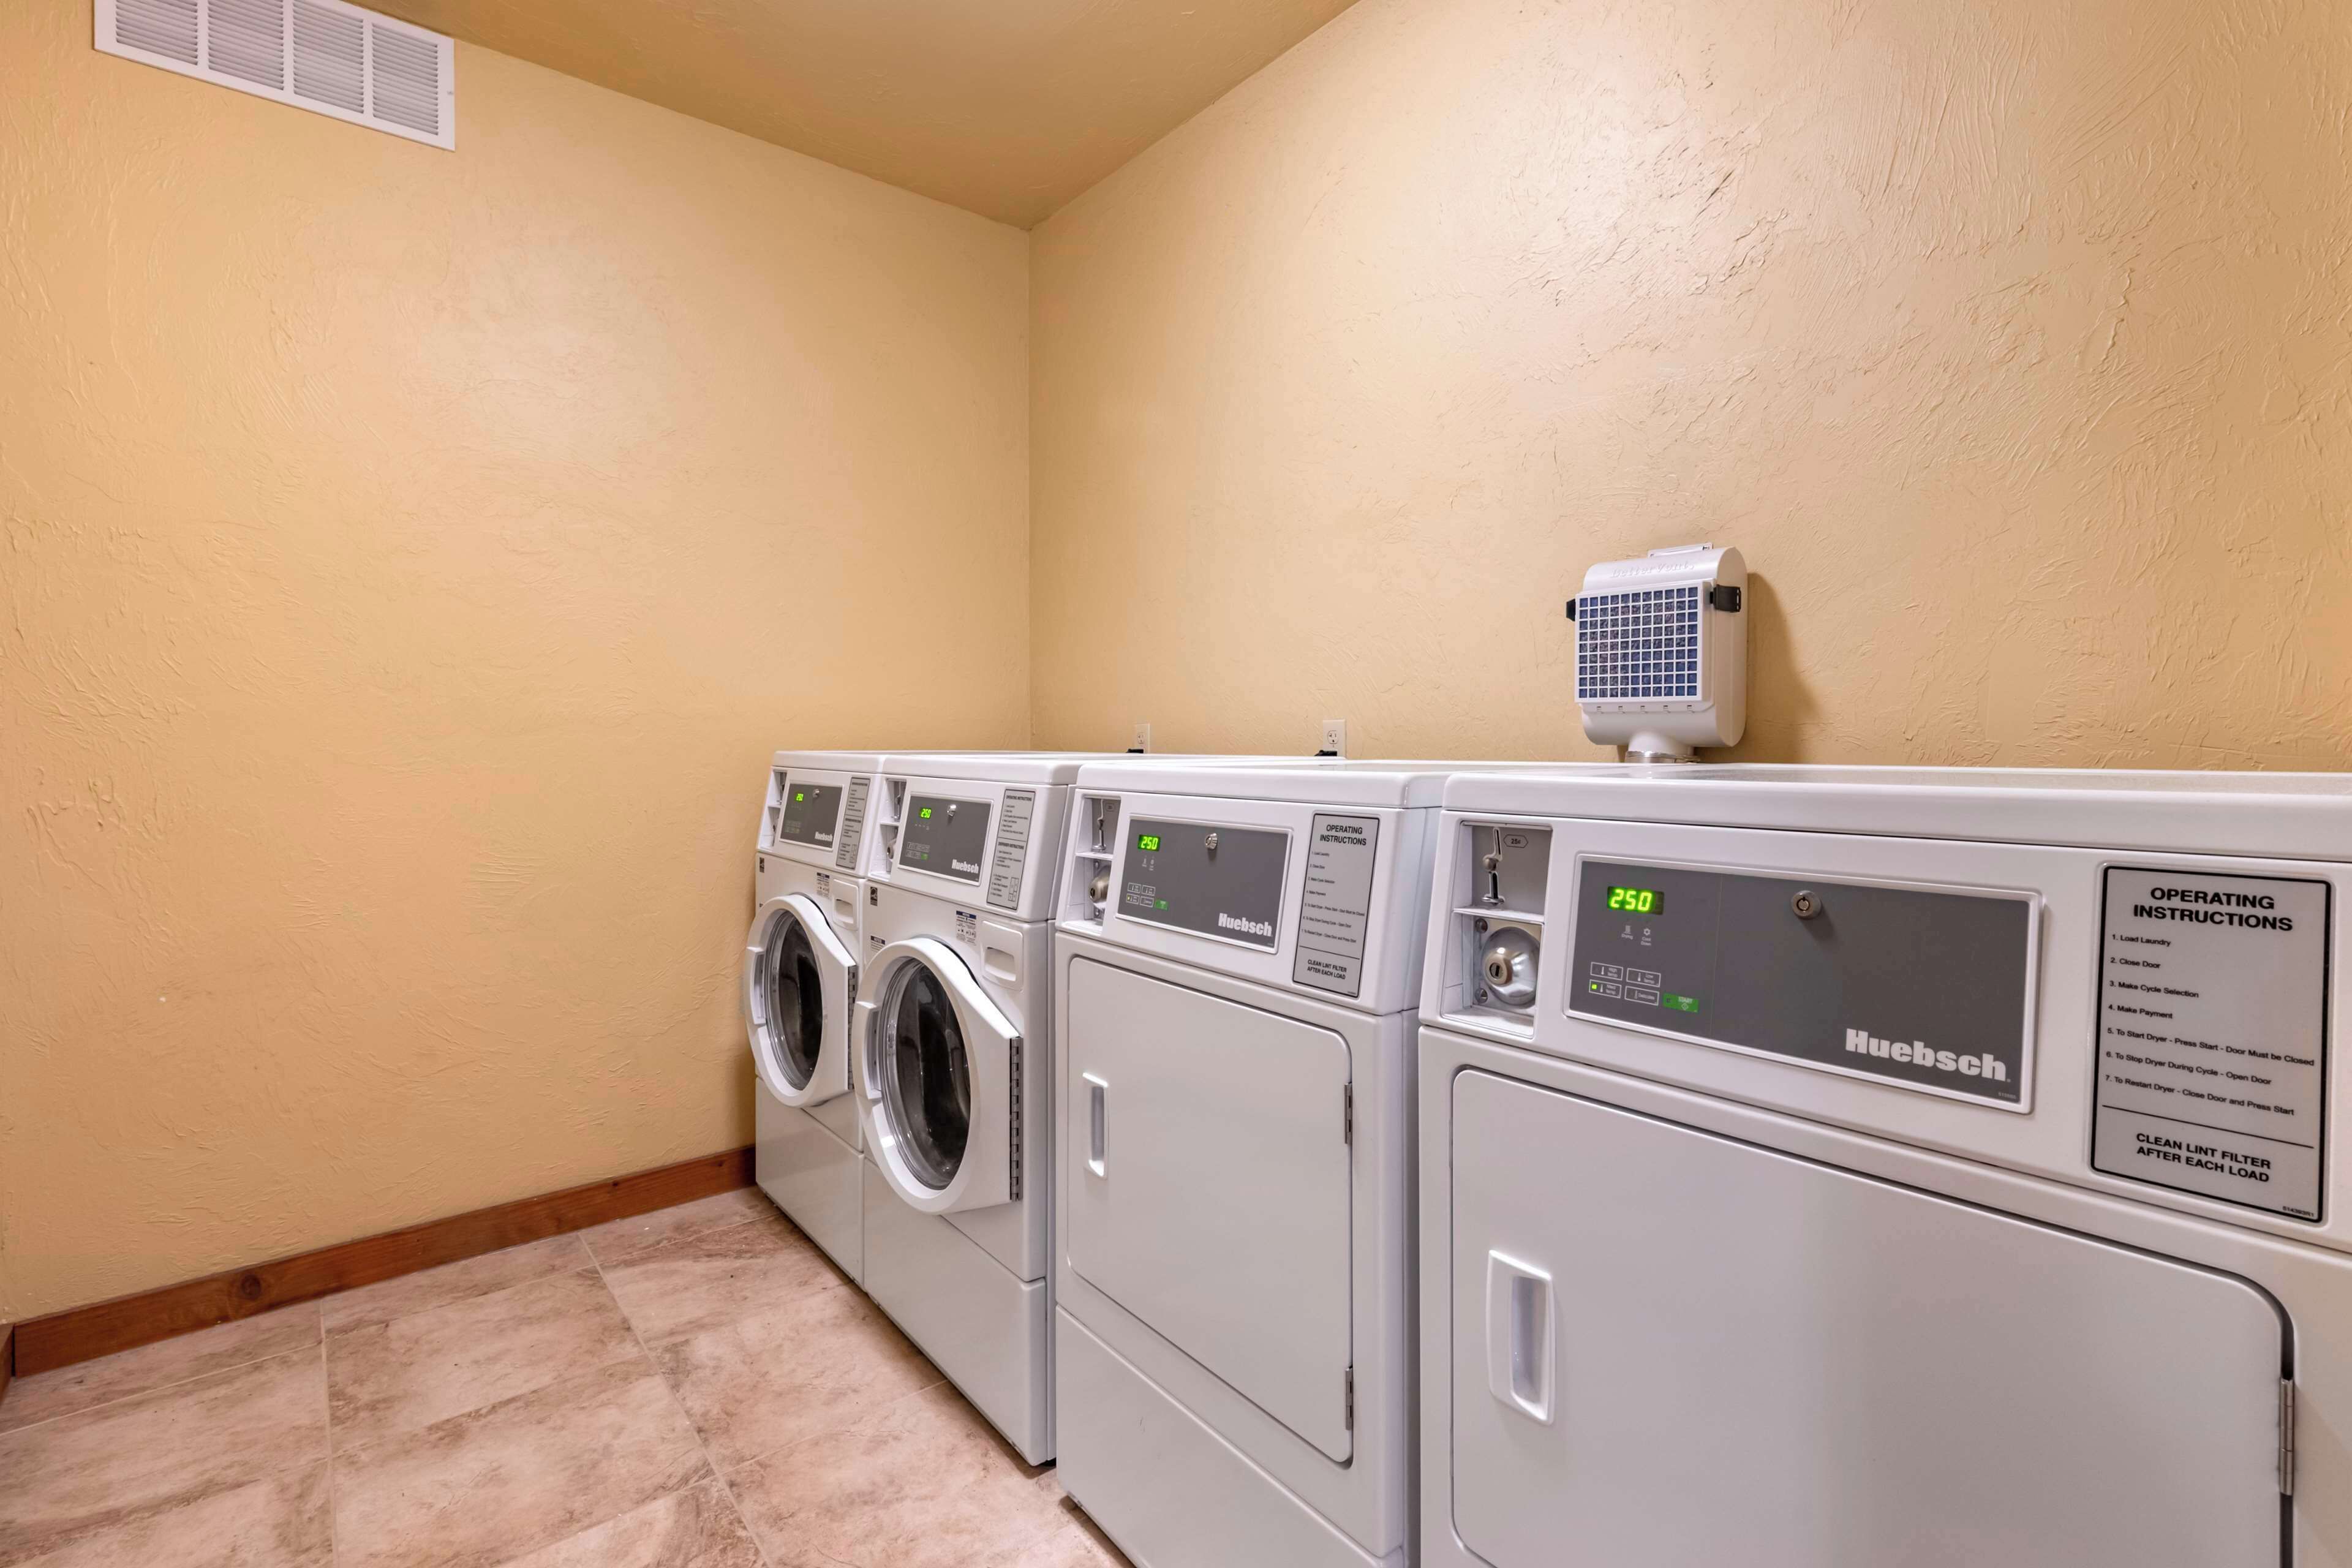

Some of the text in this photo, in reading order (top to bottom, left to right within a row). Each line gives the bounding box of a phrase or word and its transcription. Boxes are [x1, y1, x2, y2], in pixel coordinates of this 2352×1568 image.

[921, 809, 931, 818] 250
[1326, 824, 1363, 834] OPERATING
[1140, 836, 1159, 850] 250
[1320, 834, 1366, 846] INSTRUCTIONS
[952, 859, 979, 873] Huebsch
[1610, 889, 1653, 911] 250
[2150, 888, 2275, 909] OPERATING
[1218, 913, 1273, 937] Huebsch
[2133, 905, 2293, 931] INSTRUCTIONS
[2141, 937, 2171, 947] Laundry
[1308, 959, 1322, 968] CLEAN
[2119, 958, 2140, 967] Close
[2143, 960, 2161, 969] Door
[2140, 984, 2161, 993] Cycle
[2163, 987, 2199, 998] Selection
[2117, 1005, 2138, 1014] Make
[2139, 1008, 2173, 1019] Payment
[1845, 1028, 2006, 1082] Huebsch
[2127, 1030, 2145, 1039] Start
[2146, 1034, 2167, 1043] Dryer
[2174, 1038, 2196, 1047] Press
[2199, 1041, 2218, 1050] Start
[2226, 1046, 2246, 1055] Door
[2248, 1049, 2269, 1059] Must
[2284, 1055, 2314, 1066] Closed
[2126, 1054, 2143, 1063] Stop
[2145, 1057, 2166, 1067] Dryer
[2168, 1061, 2193, 1073] During
[2196, 1066, 2218, 1076] Cycle
[2226, 1071, 2248, 1080] Open
[2251, 1076, 2271, 1085] Door
[2125, 1078, 2152, 1089] Restart
[2154, 1084, 2174, 1093] Dryer
[2182, 1088, 2205, 1099] Close
[2207, 1093, 2227, 1102] Door
[2247, 1100, 2271, 1111] Press
[2274, 1105, 2294, 1116] Start
[2136, 1133, 2271, 1170] CLEAN LINT FILTER
[2136, 1146, 2269, 1182] AFTER EACH LOAD
